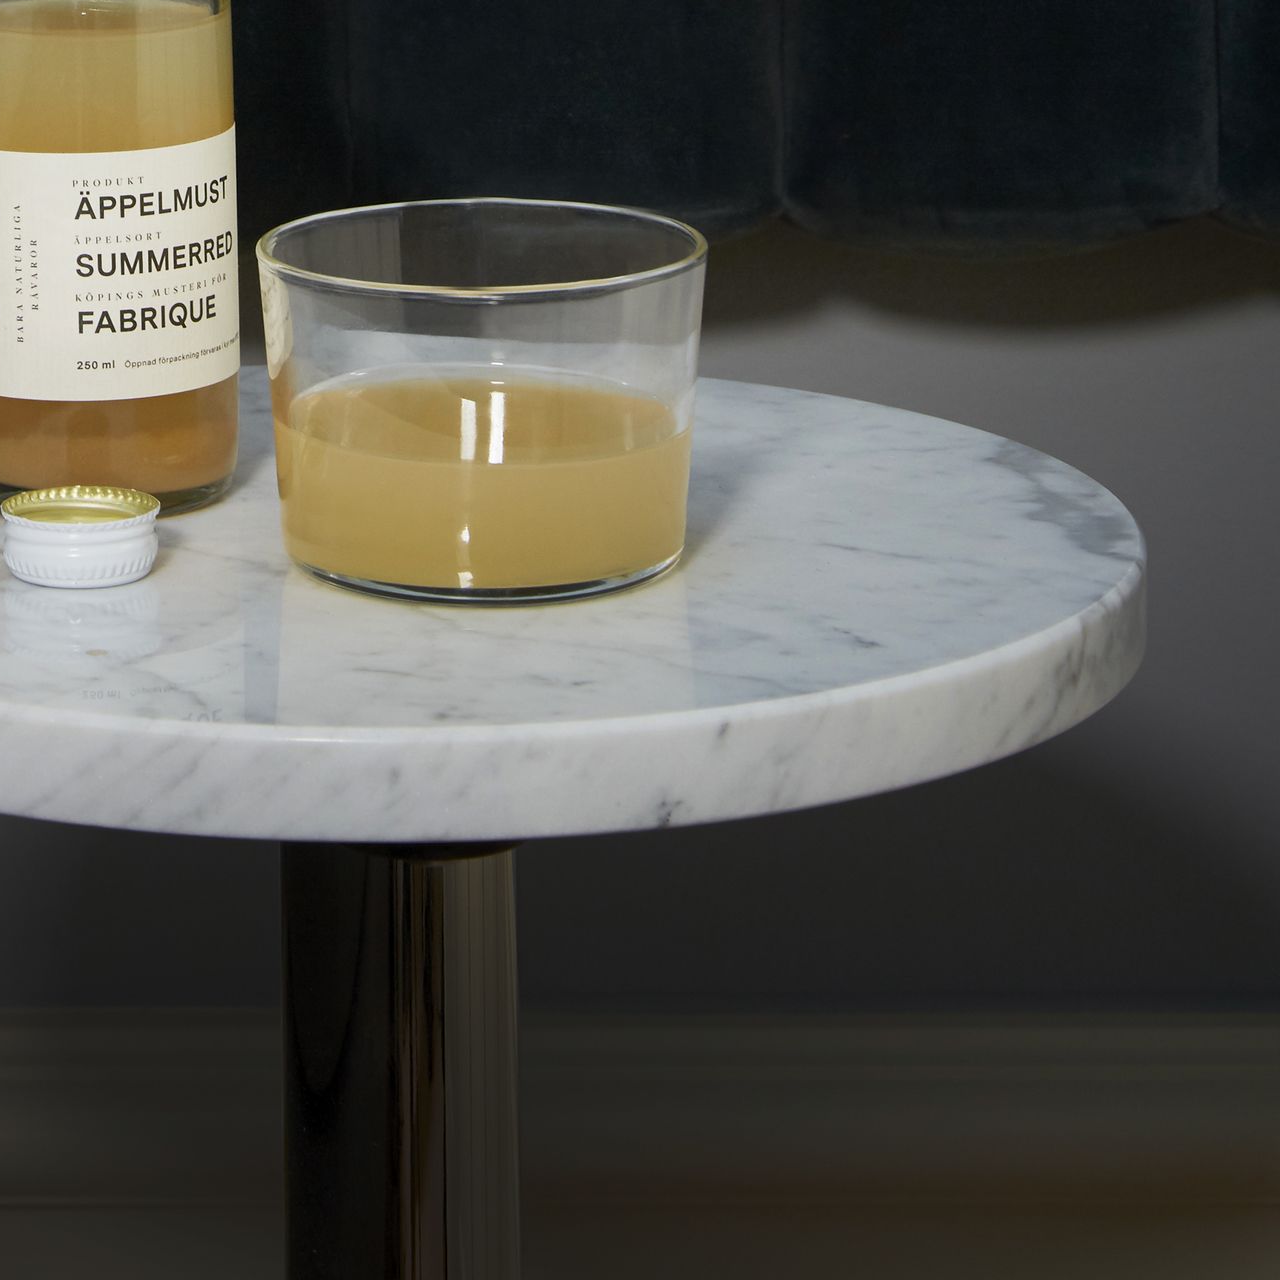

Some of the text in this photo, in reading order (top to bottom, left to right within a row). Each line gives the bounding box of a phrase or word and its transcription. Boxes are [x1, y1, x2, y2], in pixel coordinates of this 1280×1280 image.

[72, 176, 145, 188] PRODUKT
[74, 175, 228, 220] ÄPPELMUST
[73, 231, 163, 245] ÄPPELSORT
[75, 230, 233, 278] SUMMERRED
[13, 204, 24, 343] BARA NATURLIGA
[75, 273, 228, 302] KÖPINGS MUSTERI FÖR
[78, 294, 218, 334] FABRIQUE
[76, 360, 99, 370] 250
[101, 359, 116, 370] ml
[158, 351, 200, 365] förpackning
